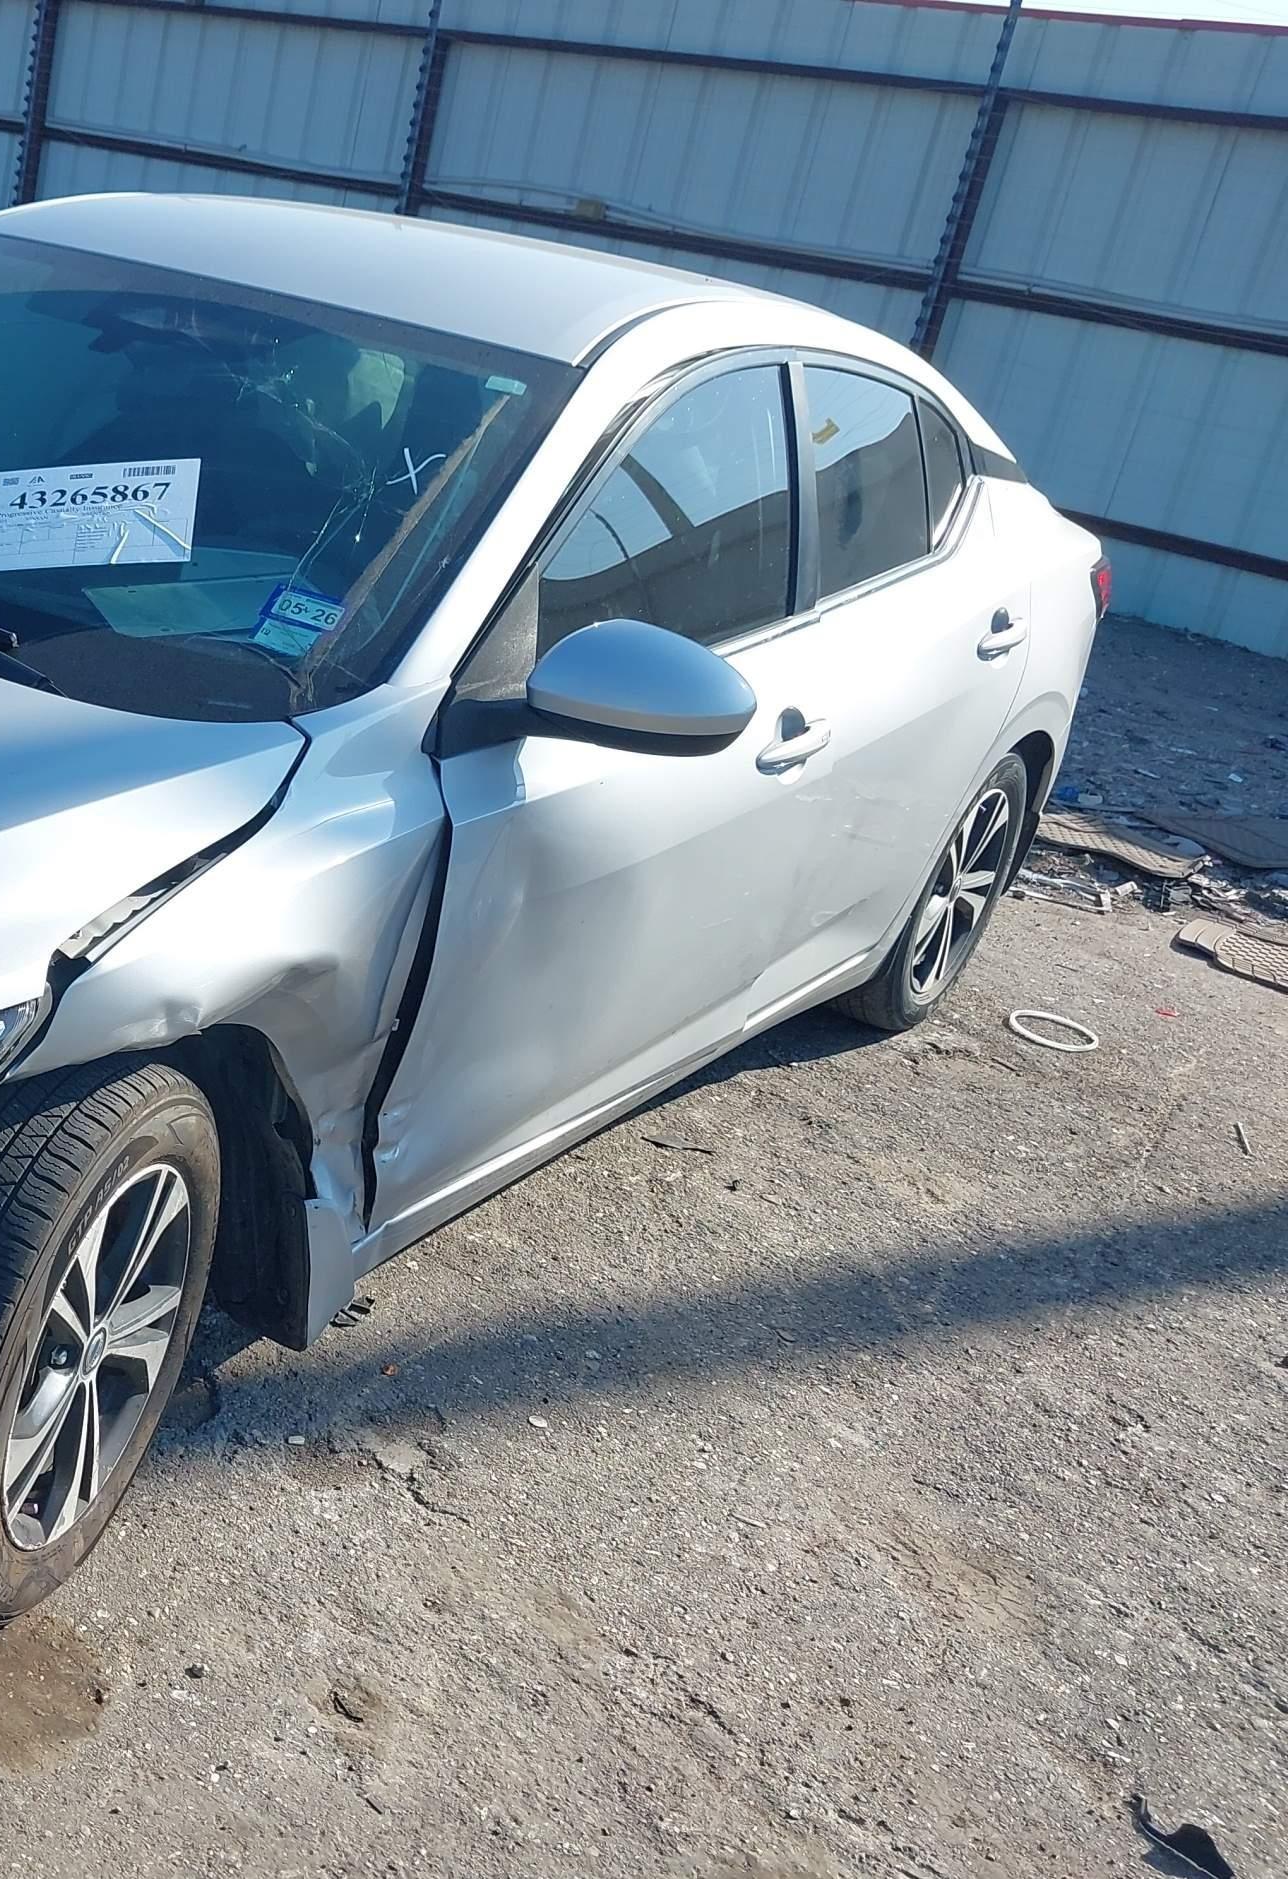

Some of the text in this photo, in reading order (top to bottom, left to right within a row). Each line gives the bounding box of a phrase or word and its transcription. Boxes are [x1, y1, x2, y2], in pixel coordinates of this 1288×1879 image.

[9, 482, 171, 510] 43265867
[45, 506, 79, 514] Casualty
[278, 599, 306, 615] 05
[310, 608, 338, 625] 26
